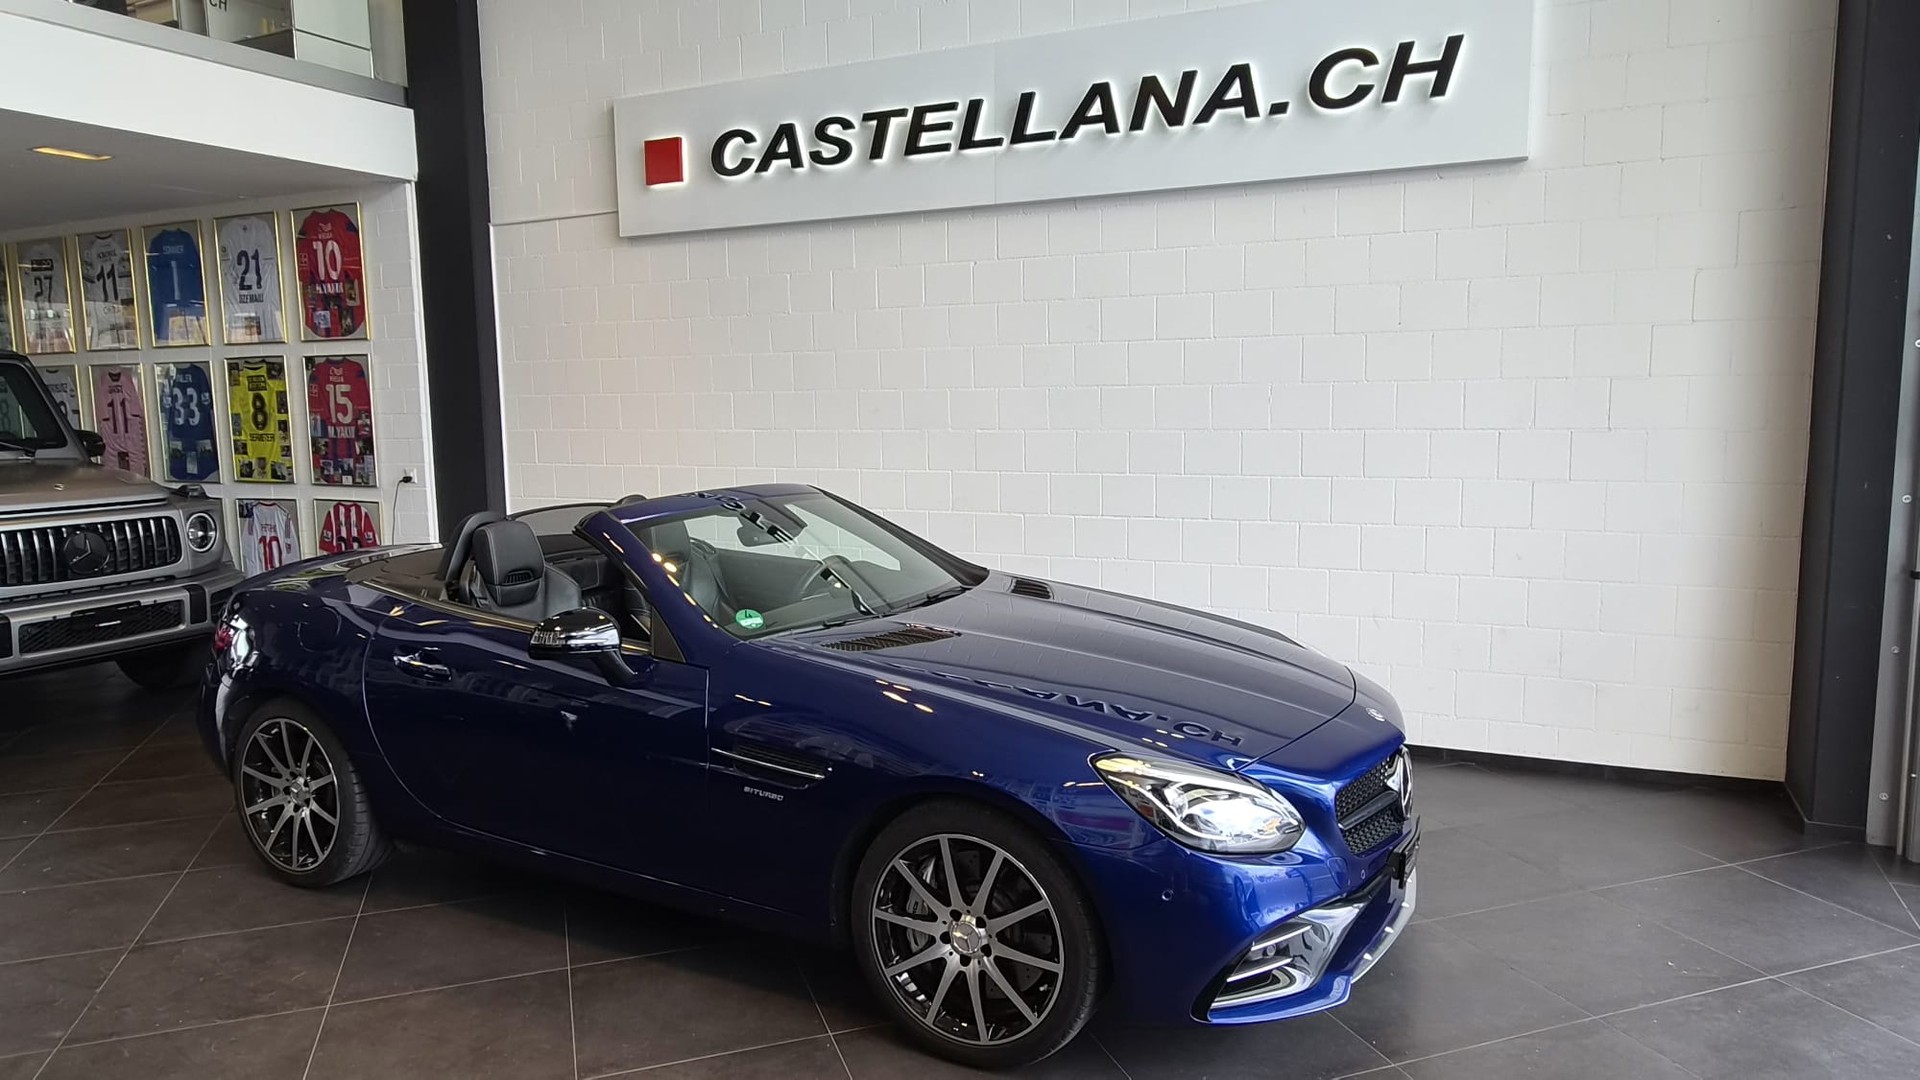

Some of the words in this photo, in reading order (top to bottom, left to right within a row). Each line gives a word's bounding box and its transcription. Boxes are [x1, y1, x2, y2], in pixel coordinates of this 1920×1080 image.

[710, 34, 1465, 178] CASTELLANA.CH
[236, 248, 263, 291] 21
[312, 239, 342, 281] 10
[33, 274, 53, 304] 27
[96, 263, 119, 302] 11
[170, 260, 181, 300] 1
[107, 398, 129, 434] 11
[172, 387, 201, 426] 33
[251, 392, 268, 431] 8
[325, 383, 353, 424] 15
[258, 535, 283, 571] 10
[743, 785, 784, 802] BITURBO
